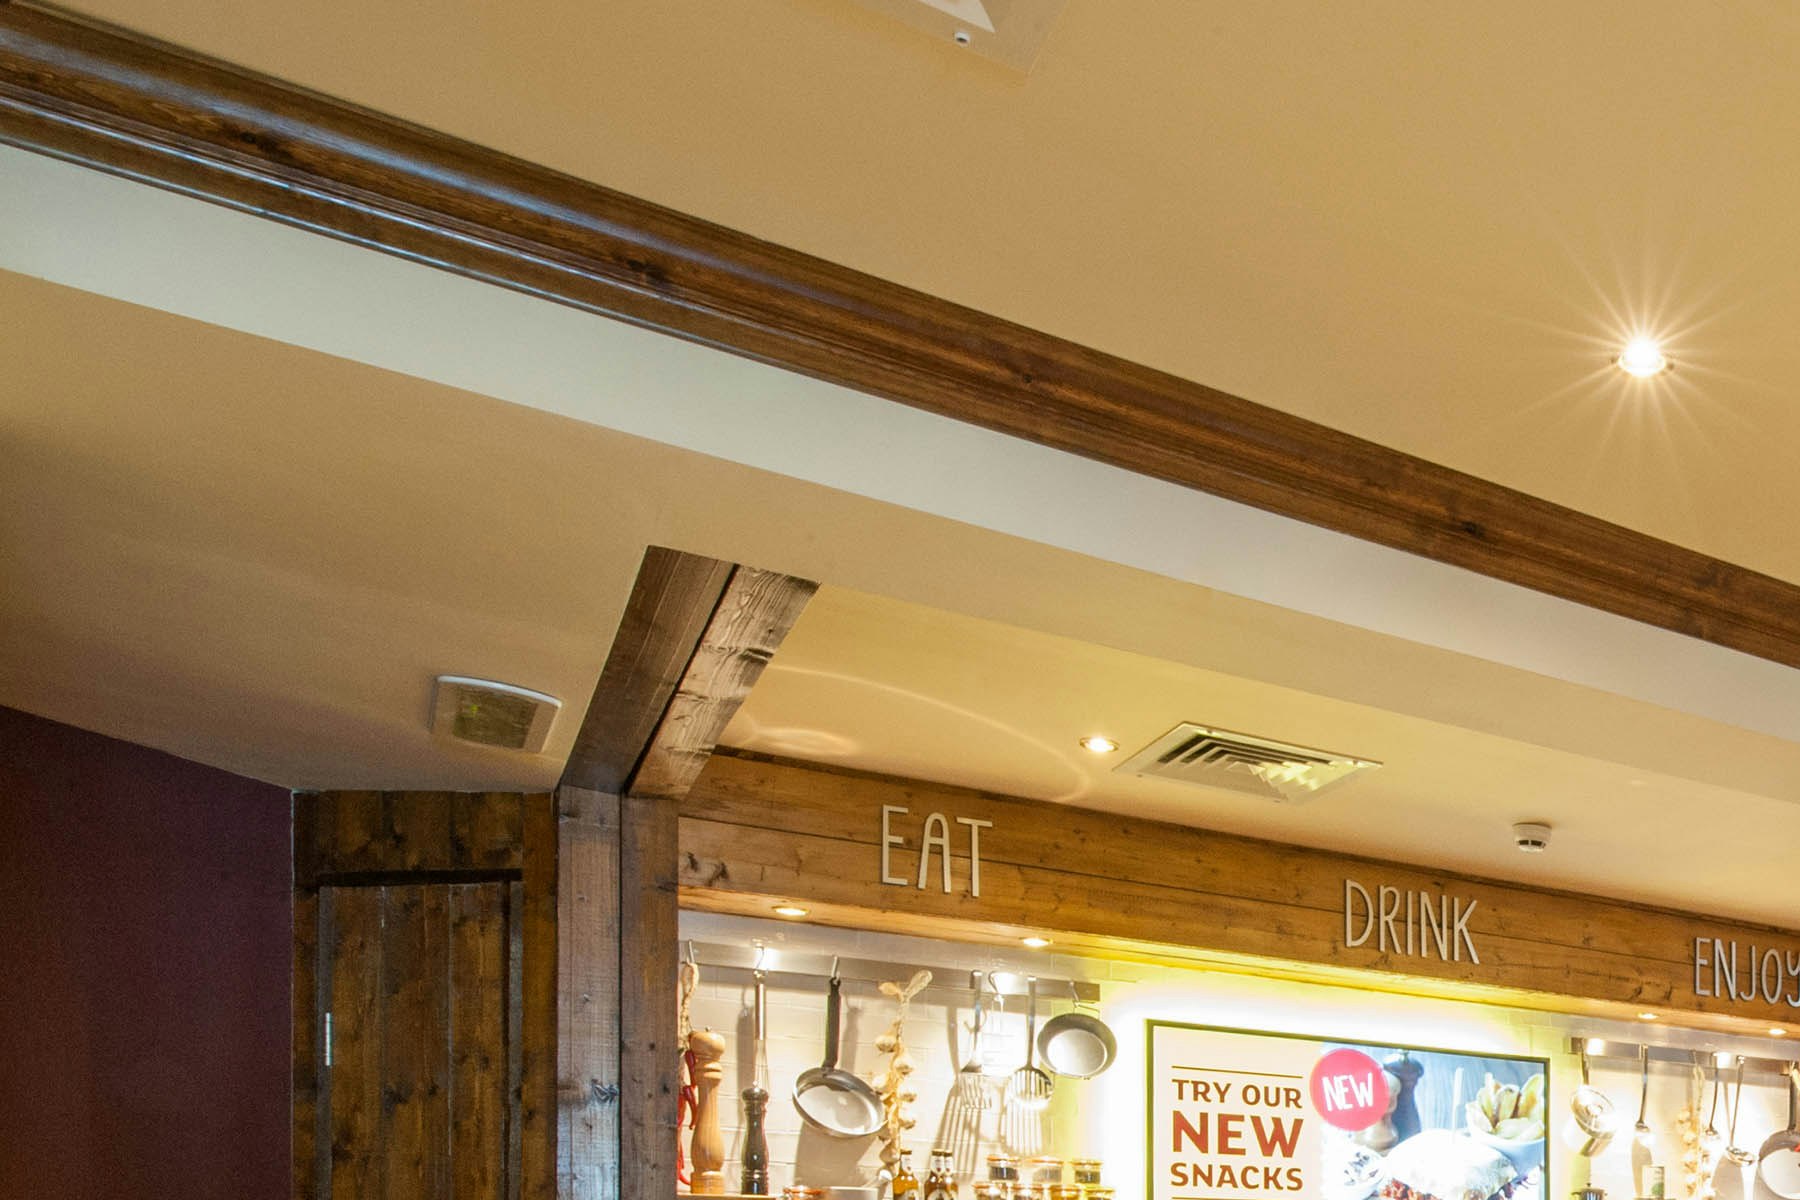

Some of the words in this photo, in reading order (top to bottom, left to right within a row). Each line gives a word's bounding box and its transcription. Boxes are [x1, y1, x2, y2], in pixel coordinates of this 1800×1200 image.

[882, 804, 993, 897] EAT
[1346, 879, 1480, 965] DRINK
[1172, 1078, 1232, 1103] TRY
[1242, 1084, 1303, 1109] OUR
[1322, 1072, 1374, 1112] NEW
[1172, 1110, 1304, 1158] NEW
[1170, 1162, 1303, 1192] SNACKS
